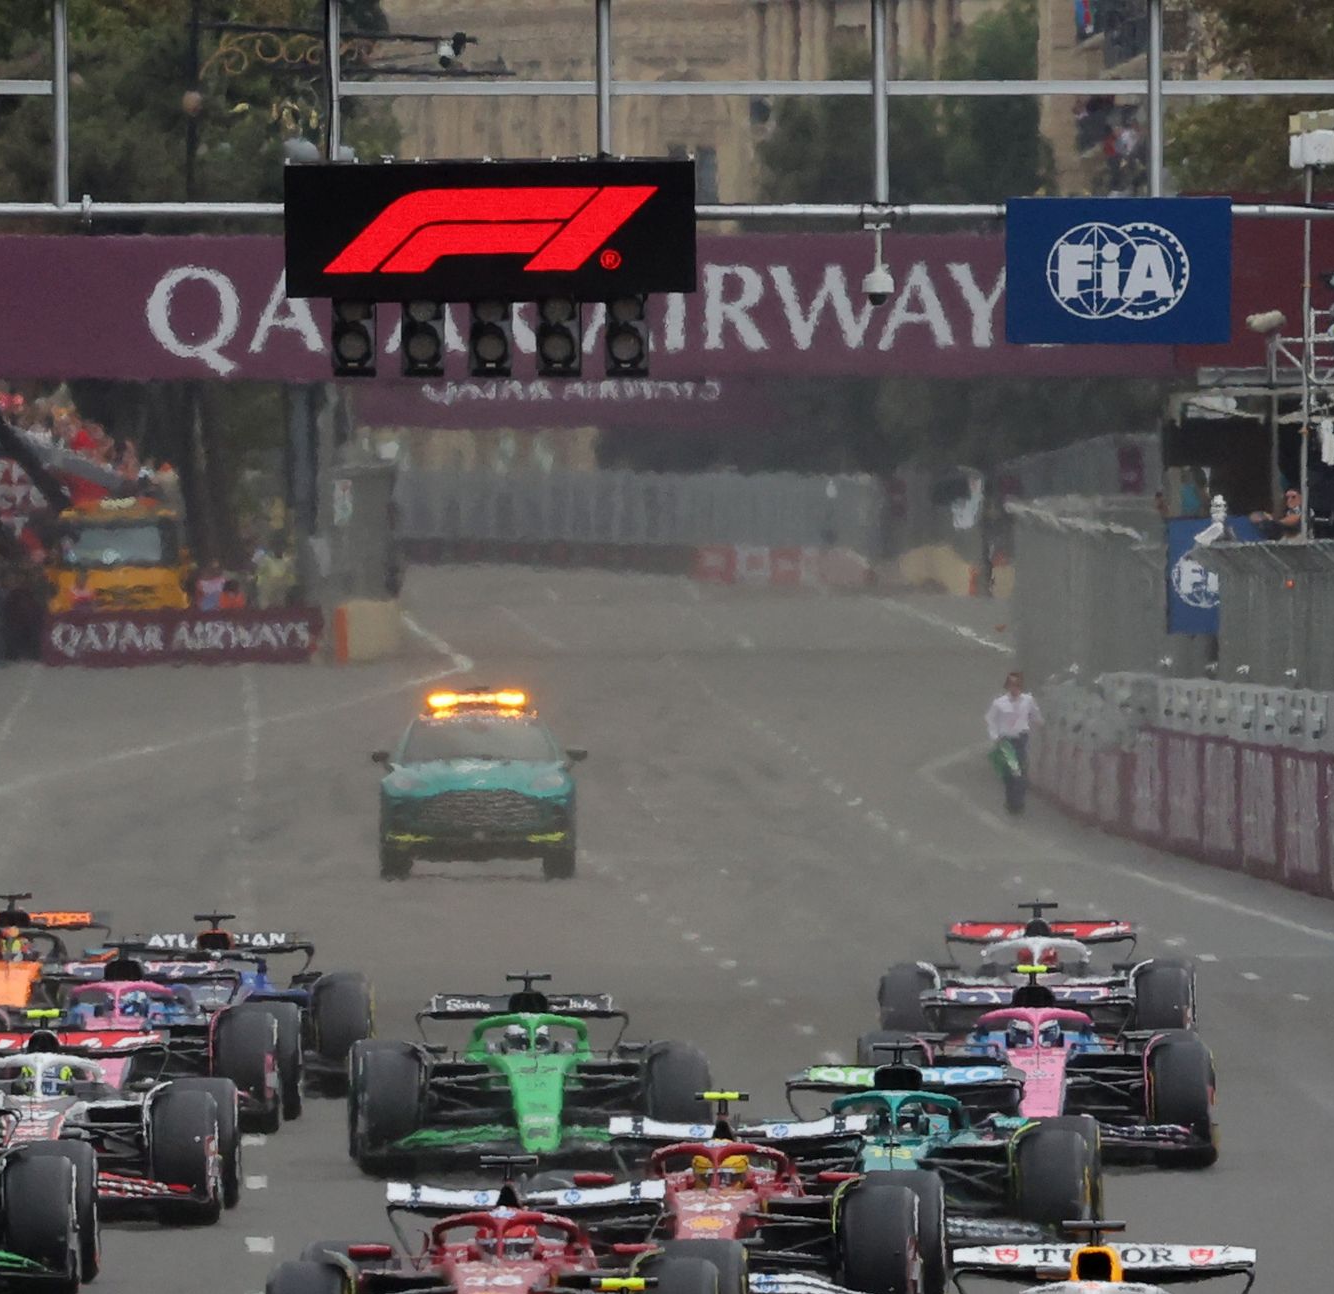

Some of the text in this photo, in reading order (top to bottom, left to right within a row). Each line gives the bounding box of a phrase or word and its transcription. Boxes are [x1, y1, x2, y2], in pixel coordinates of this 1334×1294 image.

[322, 186, 659, 274] F1
[51, 620, 311, 656] QATAR AIRWAYS
[1033, 1248, 1173, 1263] TUOR
